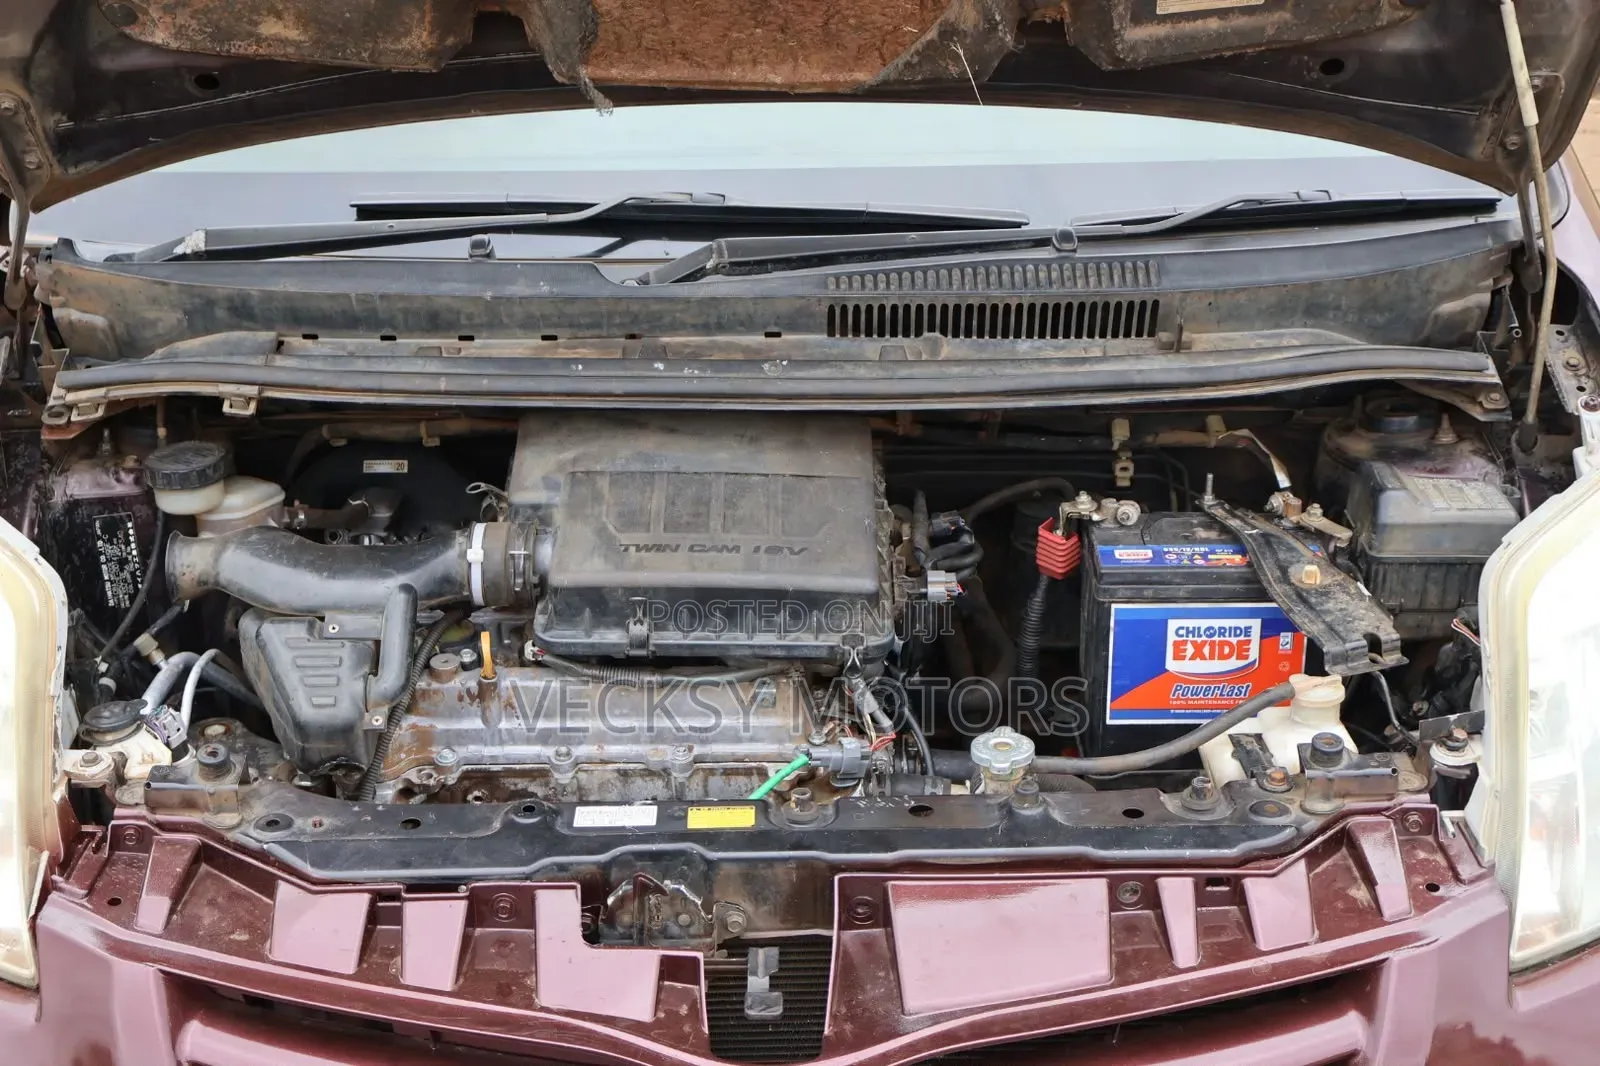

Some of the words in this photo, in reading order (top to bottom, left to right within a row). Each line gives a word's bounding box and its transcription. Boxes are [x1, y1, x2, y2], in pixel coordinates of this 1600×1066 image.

[619, 543, 681, 554] TWIN
[687, 544, 741, 555] CAM
[751, 545, 809, 556] 16V
[1174, 625, 1253, 639] CHLORIDE
[1172, 639, 1252, 661] EXIDE
